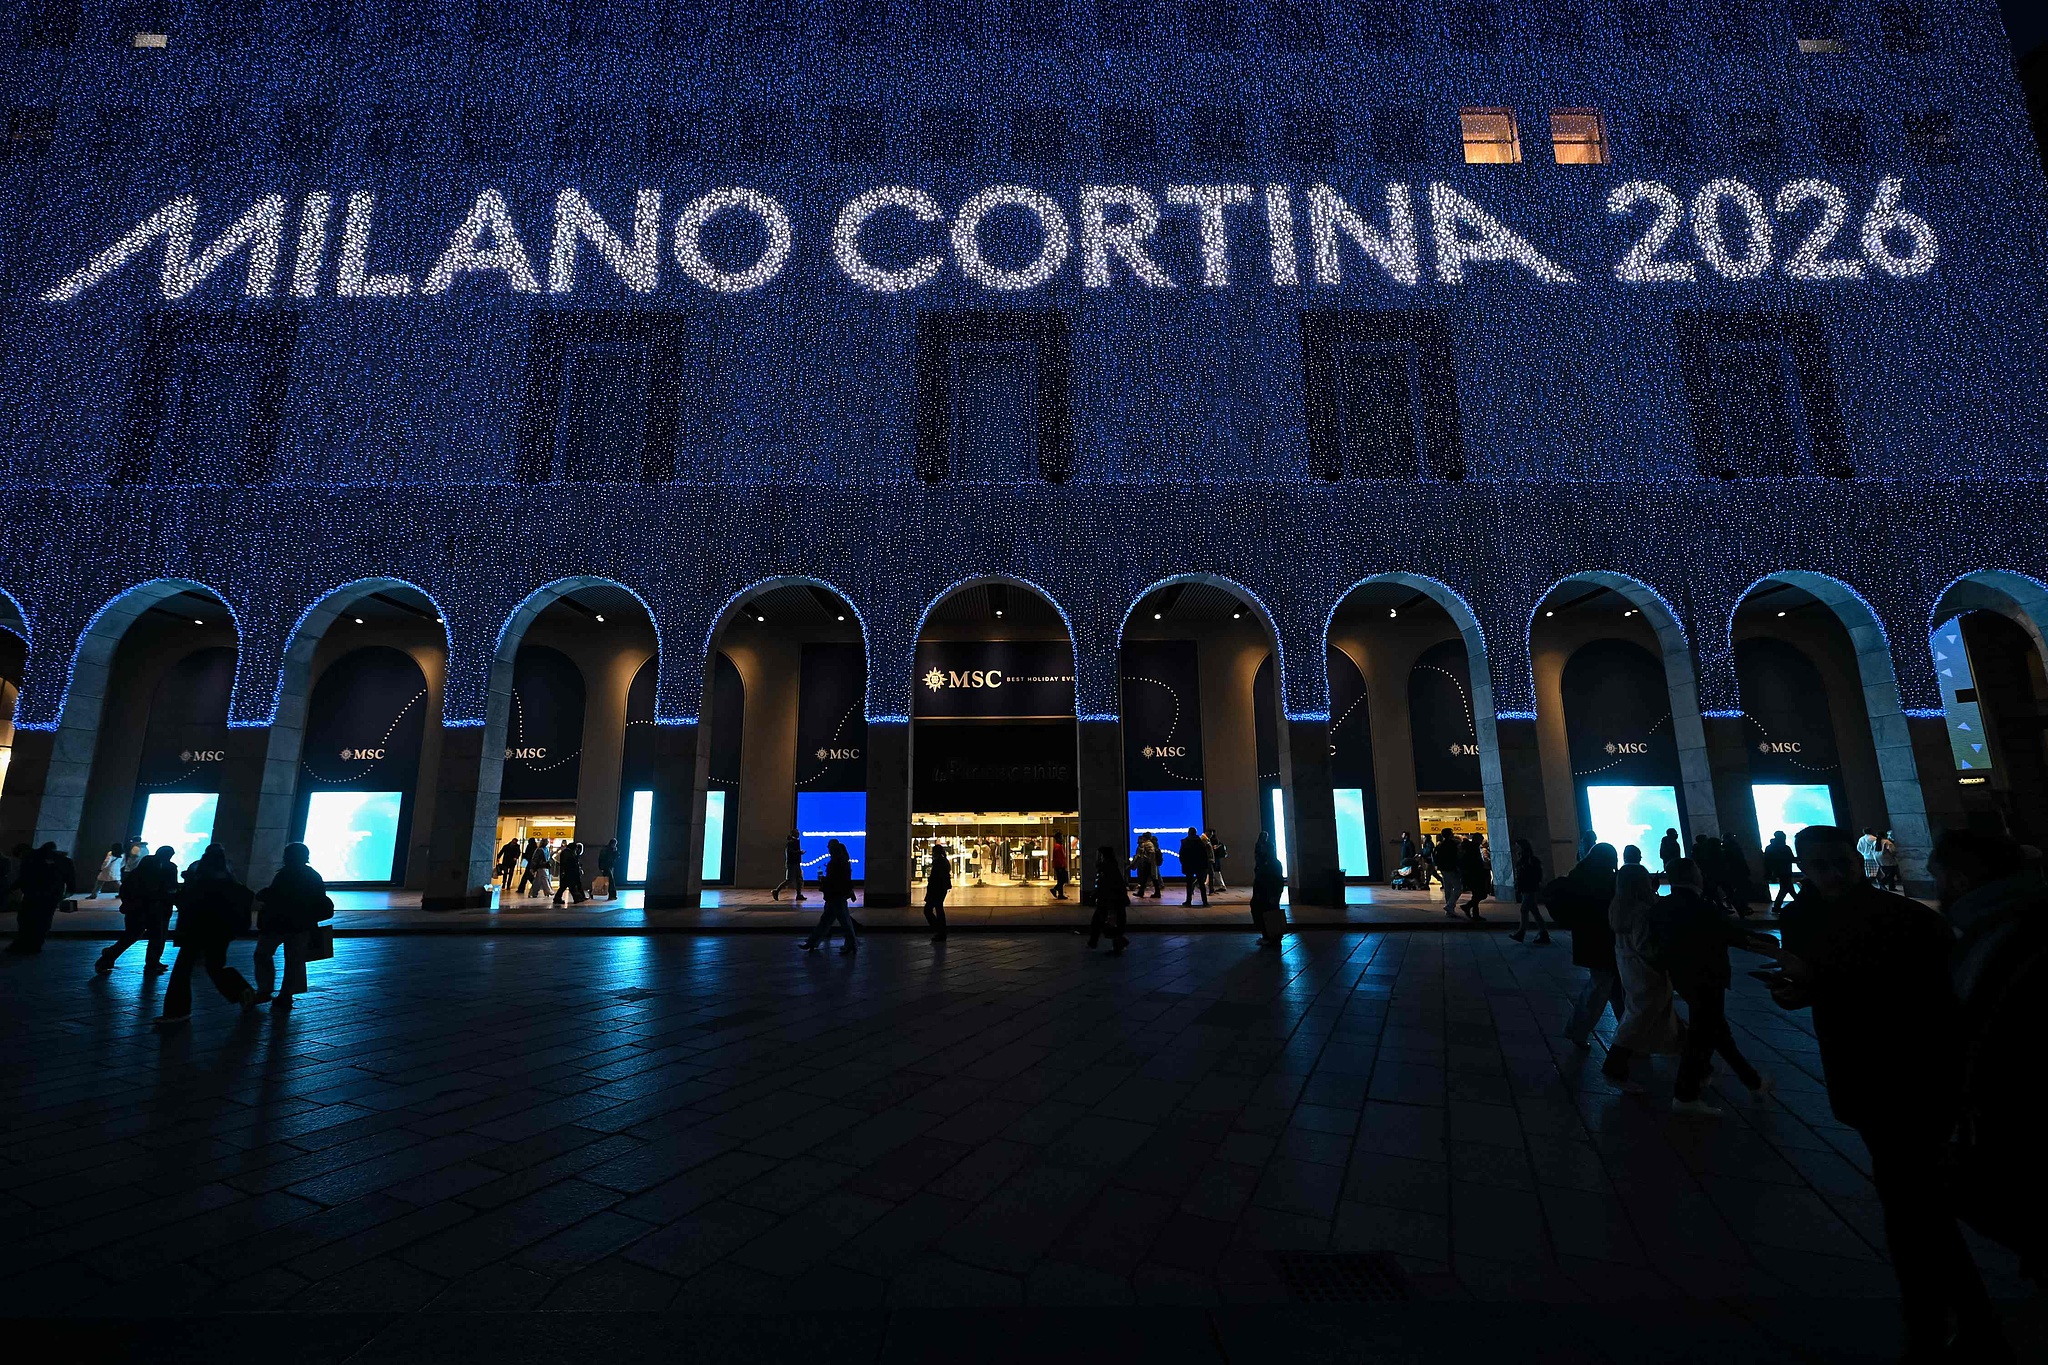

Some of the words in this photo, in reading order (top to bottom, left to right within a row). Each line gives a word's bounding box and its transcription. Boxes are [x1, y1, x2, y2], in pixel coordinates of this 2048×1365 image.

[39, 186, 793, 301] MILANO
[832, 181, 1579, 292] CORTINA
[1606, 174, 1940, 283] 2026
[948, 670, 1002, 689] MSC
[515, 747, 547, 759] MSC
[1155, 746, 1186, 757] MSC
[1617, 742, 1648, 754] MSC
[1771, 742, 1802, 753] MSC
[193, 750, 225, 762] MSC
[353, 748, 385, 760] MSC
[829, 748, 860, 760] MSC
